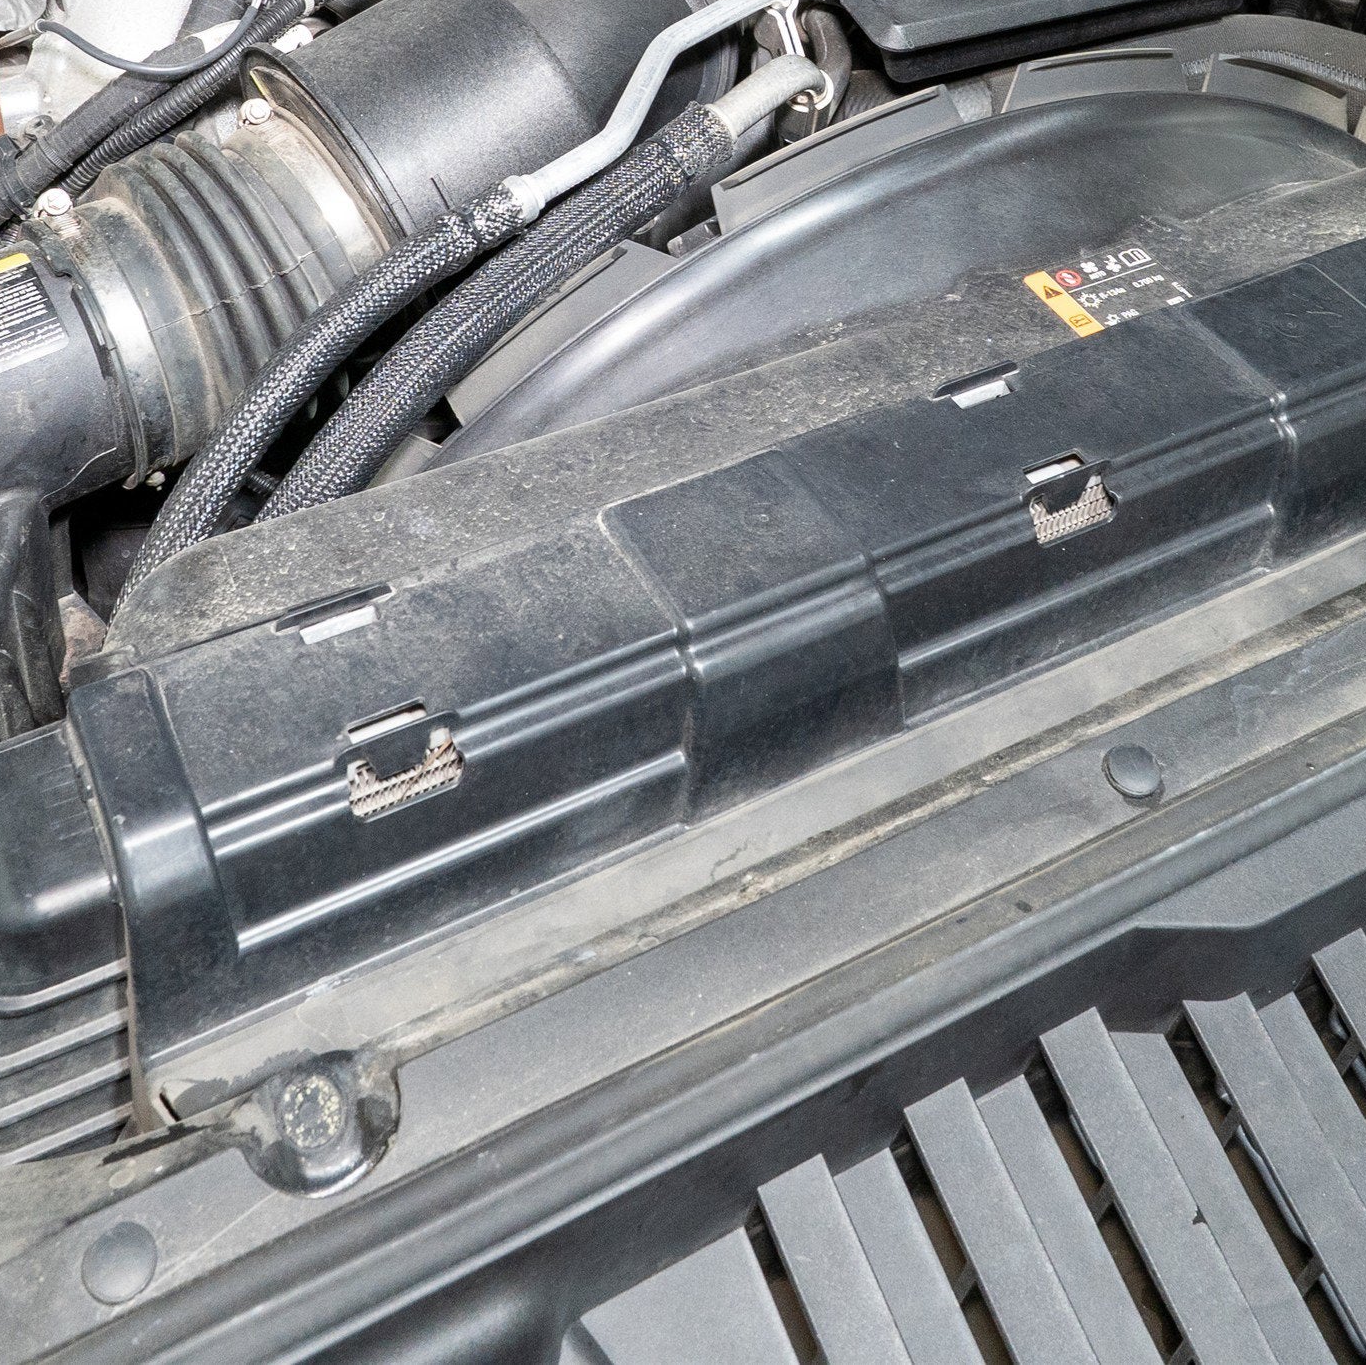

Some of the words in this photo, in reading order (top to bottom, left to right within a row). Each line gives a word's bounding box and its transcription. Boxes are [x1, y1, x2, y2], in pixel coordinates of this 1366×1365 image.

[1088, 271, 1107, 280] AUTO
[1098, 287, 1127, 299] R-134a
[1153, 274, 1165, 284] kg
[1120, 308, 1139, 319] PAG
